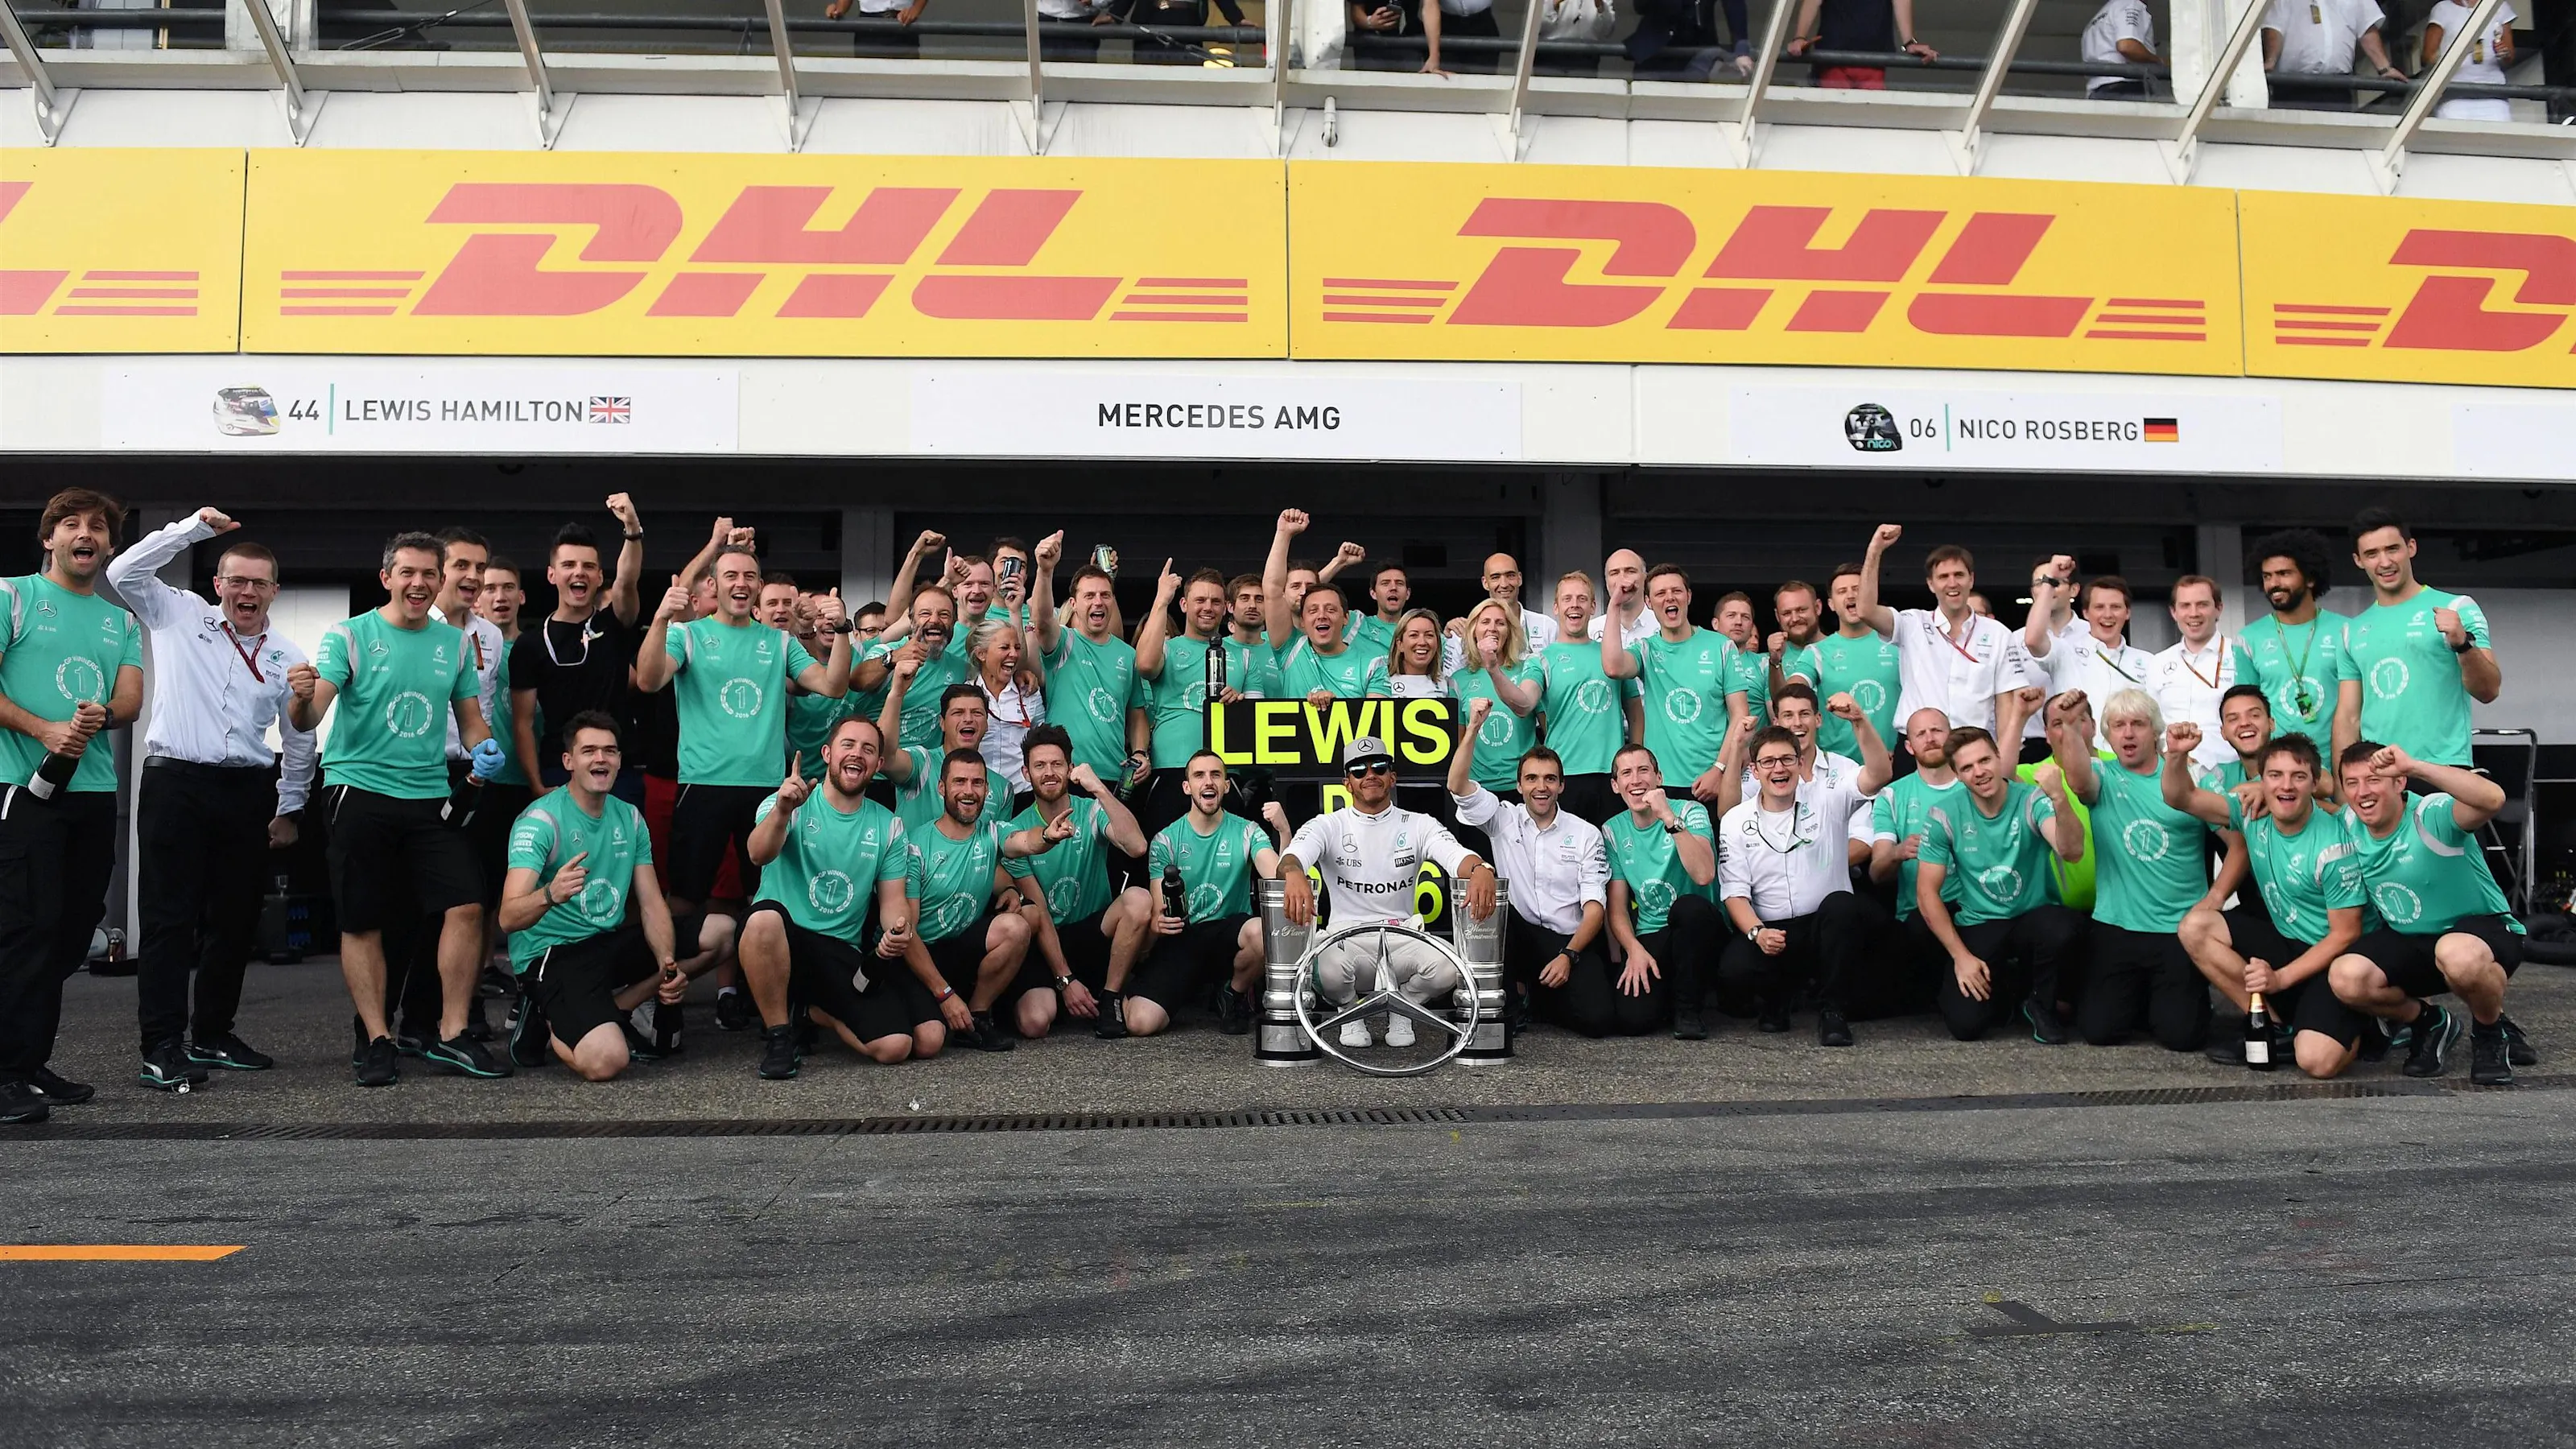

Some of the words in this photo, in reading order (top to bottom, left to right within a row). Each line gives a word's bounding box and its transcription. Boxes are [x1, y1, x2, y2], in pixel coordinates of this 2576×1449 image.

[410, 183, 1124, 320] DHL
[1446, 197, 2095, 338] DHL
[288, 399, 320, 421] 44
[345, 399, 431, 422] LEWIS
[441, 399, 583, 423] HAMILTON
[1098, 403, 1265, 428] MERCEDES
[1274, 406, 1340, 430] AMG
[1910, 419, 1936, 438] 06
[1959, 419, 2017, 440] NICO
[2025, 420, 2138, 441] ROSBERG
[72, 655, 98, 671] WINNERS
[402, 691, 428, 704] WINNERS
[398, 730, 415, 738] 2016
[1210, 699, 1451, 765] LEWIS
[1346, 858, 1362, 868] UBS
[1395, 855, 1414, 868] BOSS
[818, 870, 827, 879] GP
[1337, 875, 1414, 894] PETRONAS
[819, 906, 834, 914] 2016
